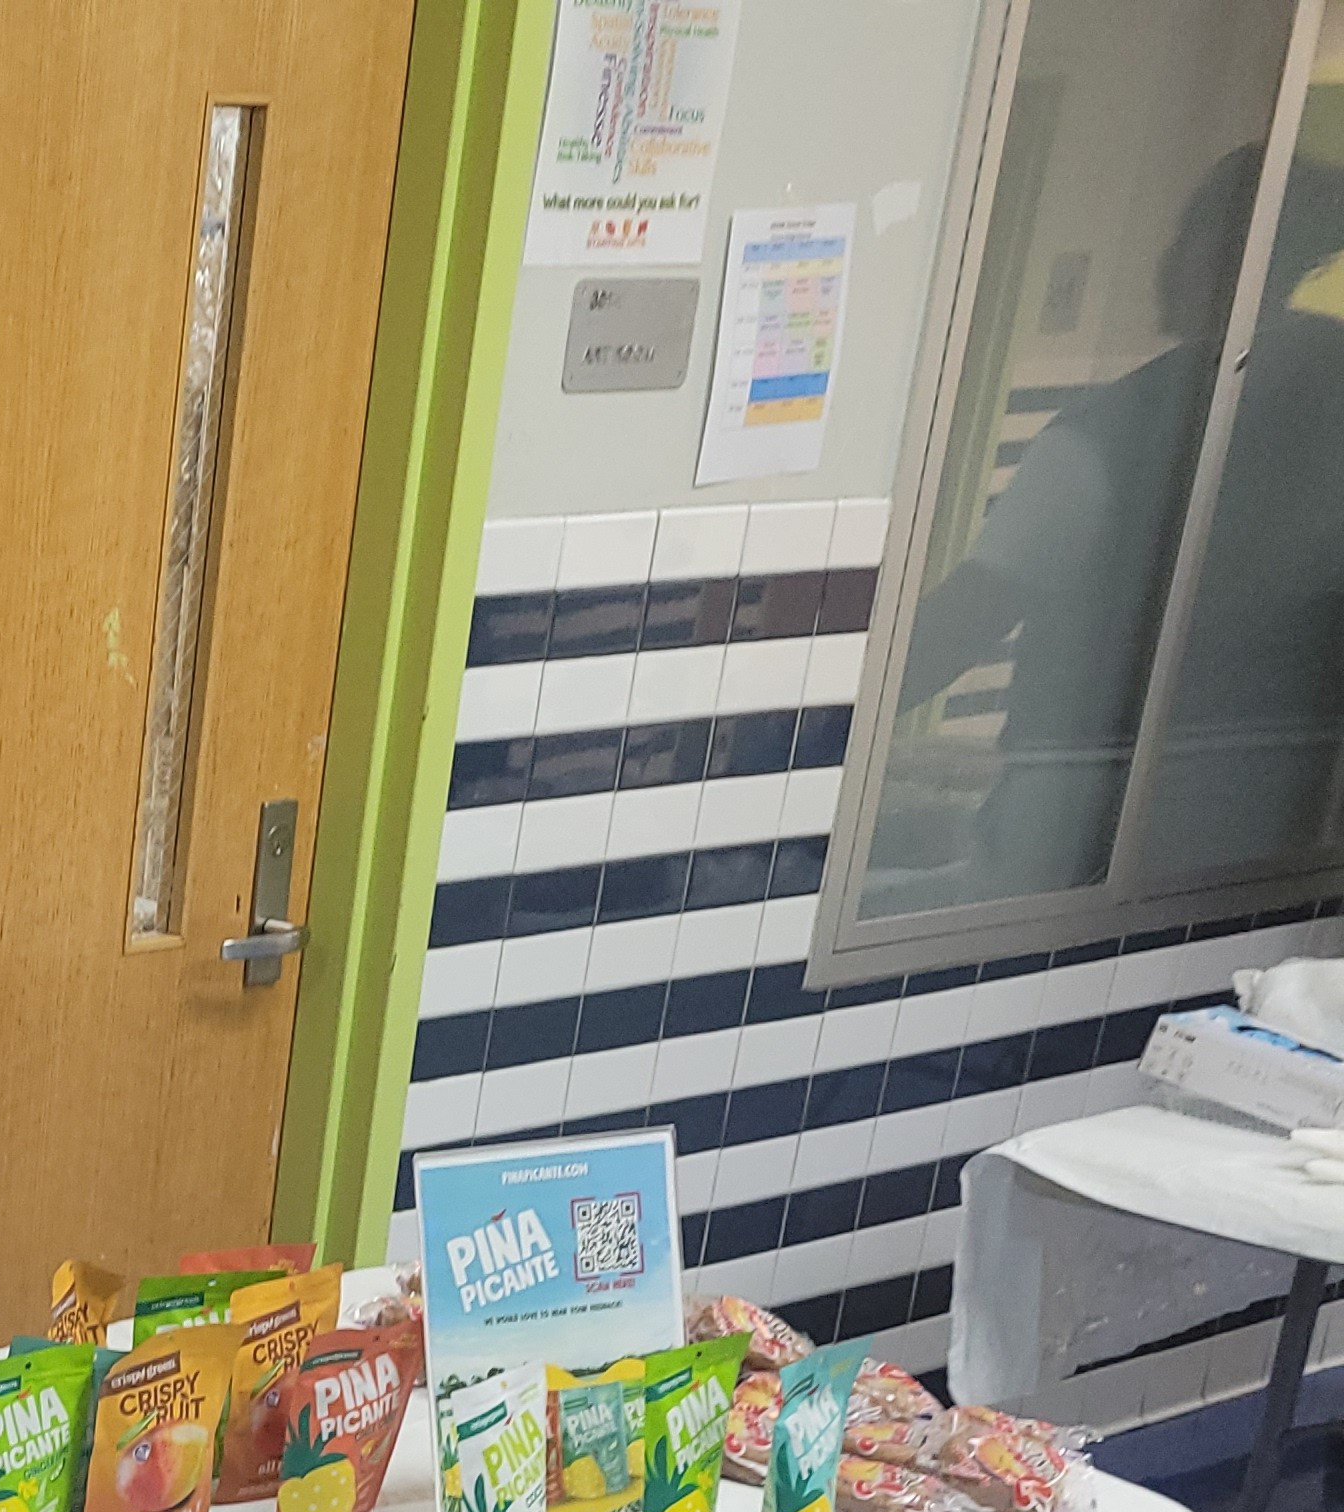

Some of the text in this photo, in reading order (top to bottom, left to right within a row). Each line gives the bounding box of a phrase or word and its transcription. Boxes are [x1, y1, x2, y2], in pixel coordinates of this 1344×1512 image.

[544, 192, 571, 210] What
[574, 196, 603, 210] more
[607, 192, 637, 210] could
[635, 197, 657, 214] you
[659, 192, 675, 209] ask
[460, 1251, 559, 1313] PICANTE
[118, 1369, 200, 1417] CRISPY
[320, 1389, 401, 1442] PICANTE
[496, 1450, 546, 1511] PICAN
